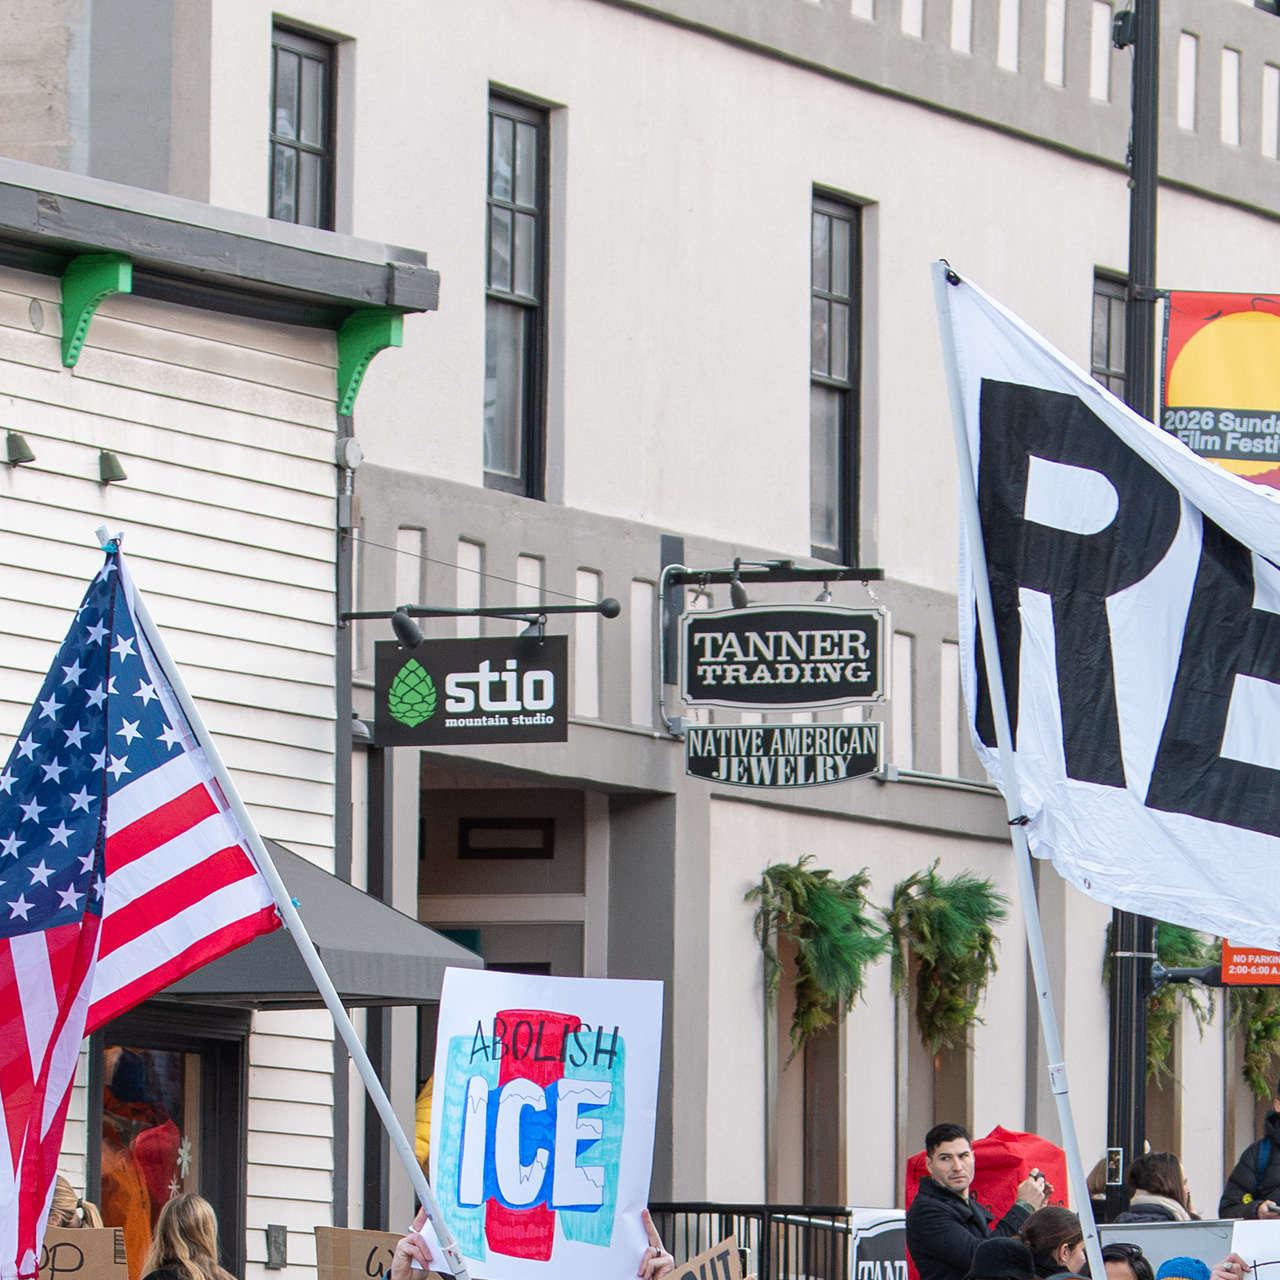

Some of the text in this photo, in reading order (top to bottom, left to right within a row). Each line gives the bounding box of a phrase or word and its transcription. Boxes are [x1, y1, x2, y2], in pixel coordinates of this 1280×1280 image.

[1164, 410, 1215, 430] 2026
[693, 629, 870, 663] TANNER
[445, 659, 554, 713] stio
[696, 662, 871, 685] TRADING
[445, 713, 554, 728] mountain studio
[689, 726, 877, 757] NATIVE AMERICAN
[712, 755, 852, 786] JEWELRY
[1229, 965, 1270, 975] 2:00-6:00
[1233, 954, 1247, 963] NO
[470, 1017, 619, 1070] ABOLISH
[457, 1075, 613, 1210] ICE
